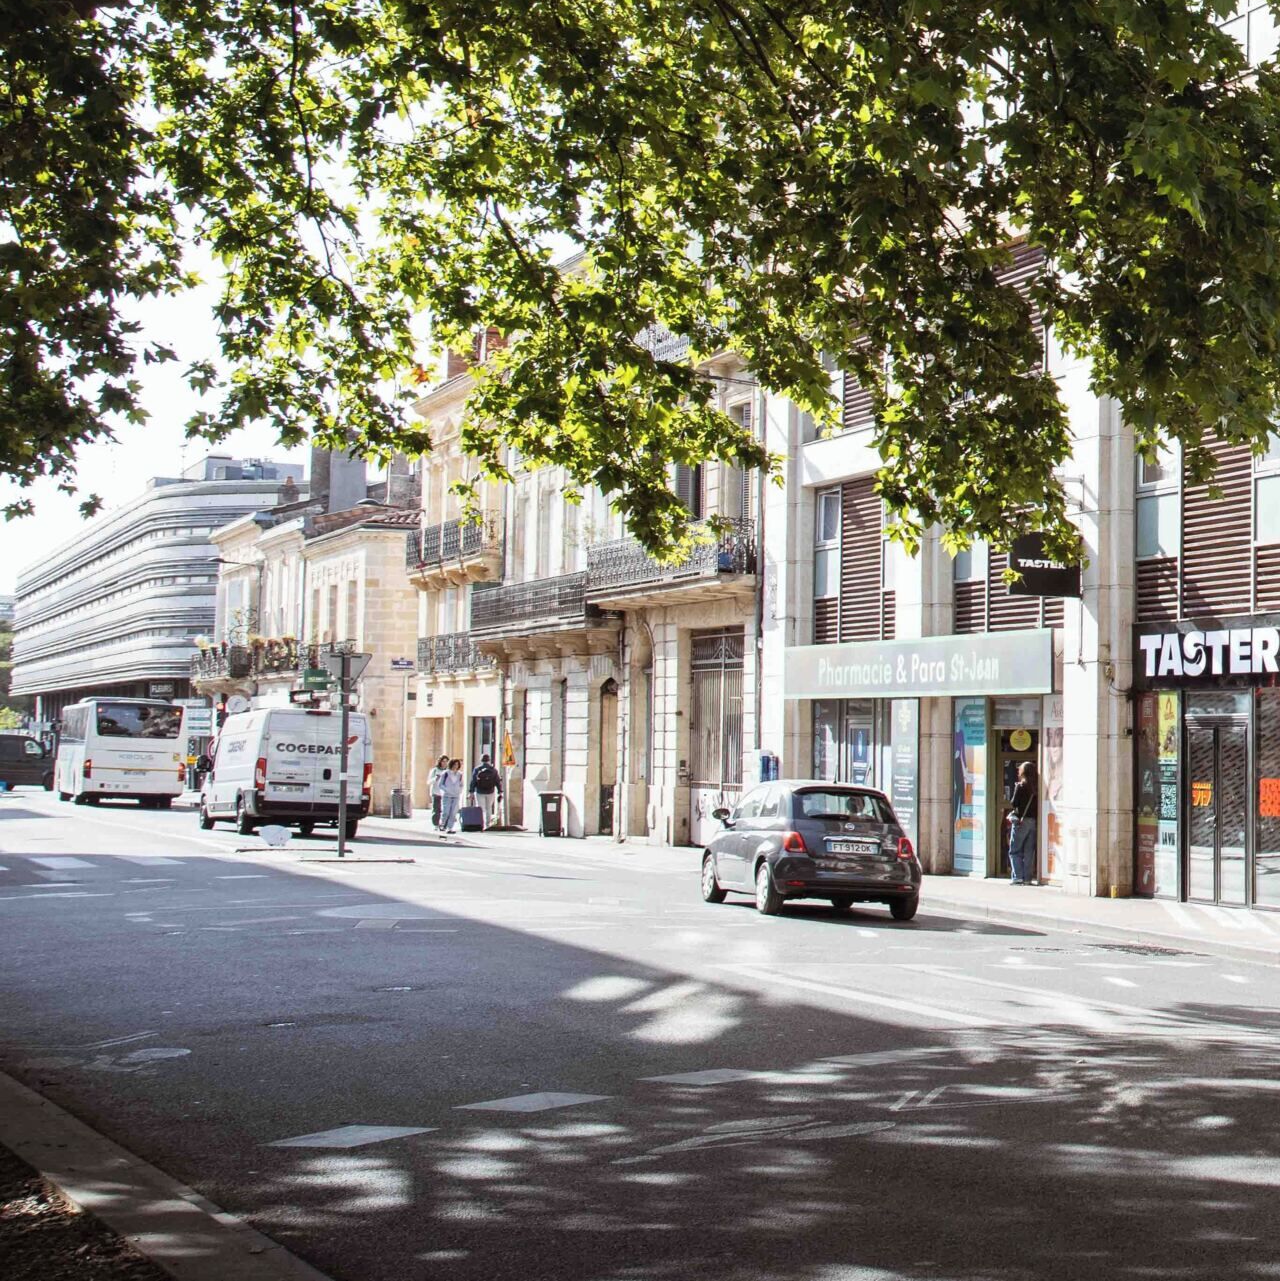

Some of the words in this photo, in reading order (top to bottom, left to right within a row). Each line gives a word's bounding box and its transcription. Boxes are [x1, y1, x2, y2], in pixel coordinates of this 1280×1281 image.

[818, 654, 892, 686] Pharmacie
[896, 654, 908, 683] &
[911, 653, 946, 683] Para
[949, 651, 1000, 682] St-Jean
[1139, 627, 1280, 677] TASTER
[276, 742, 352, 755] COGEPAR
